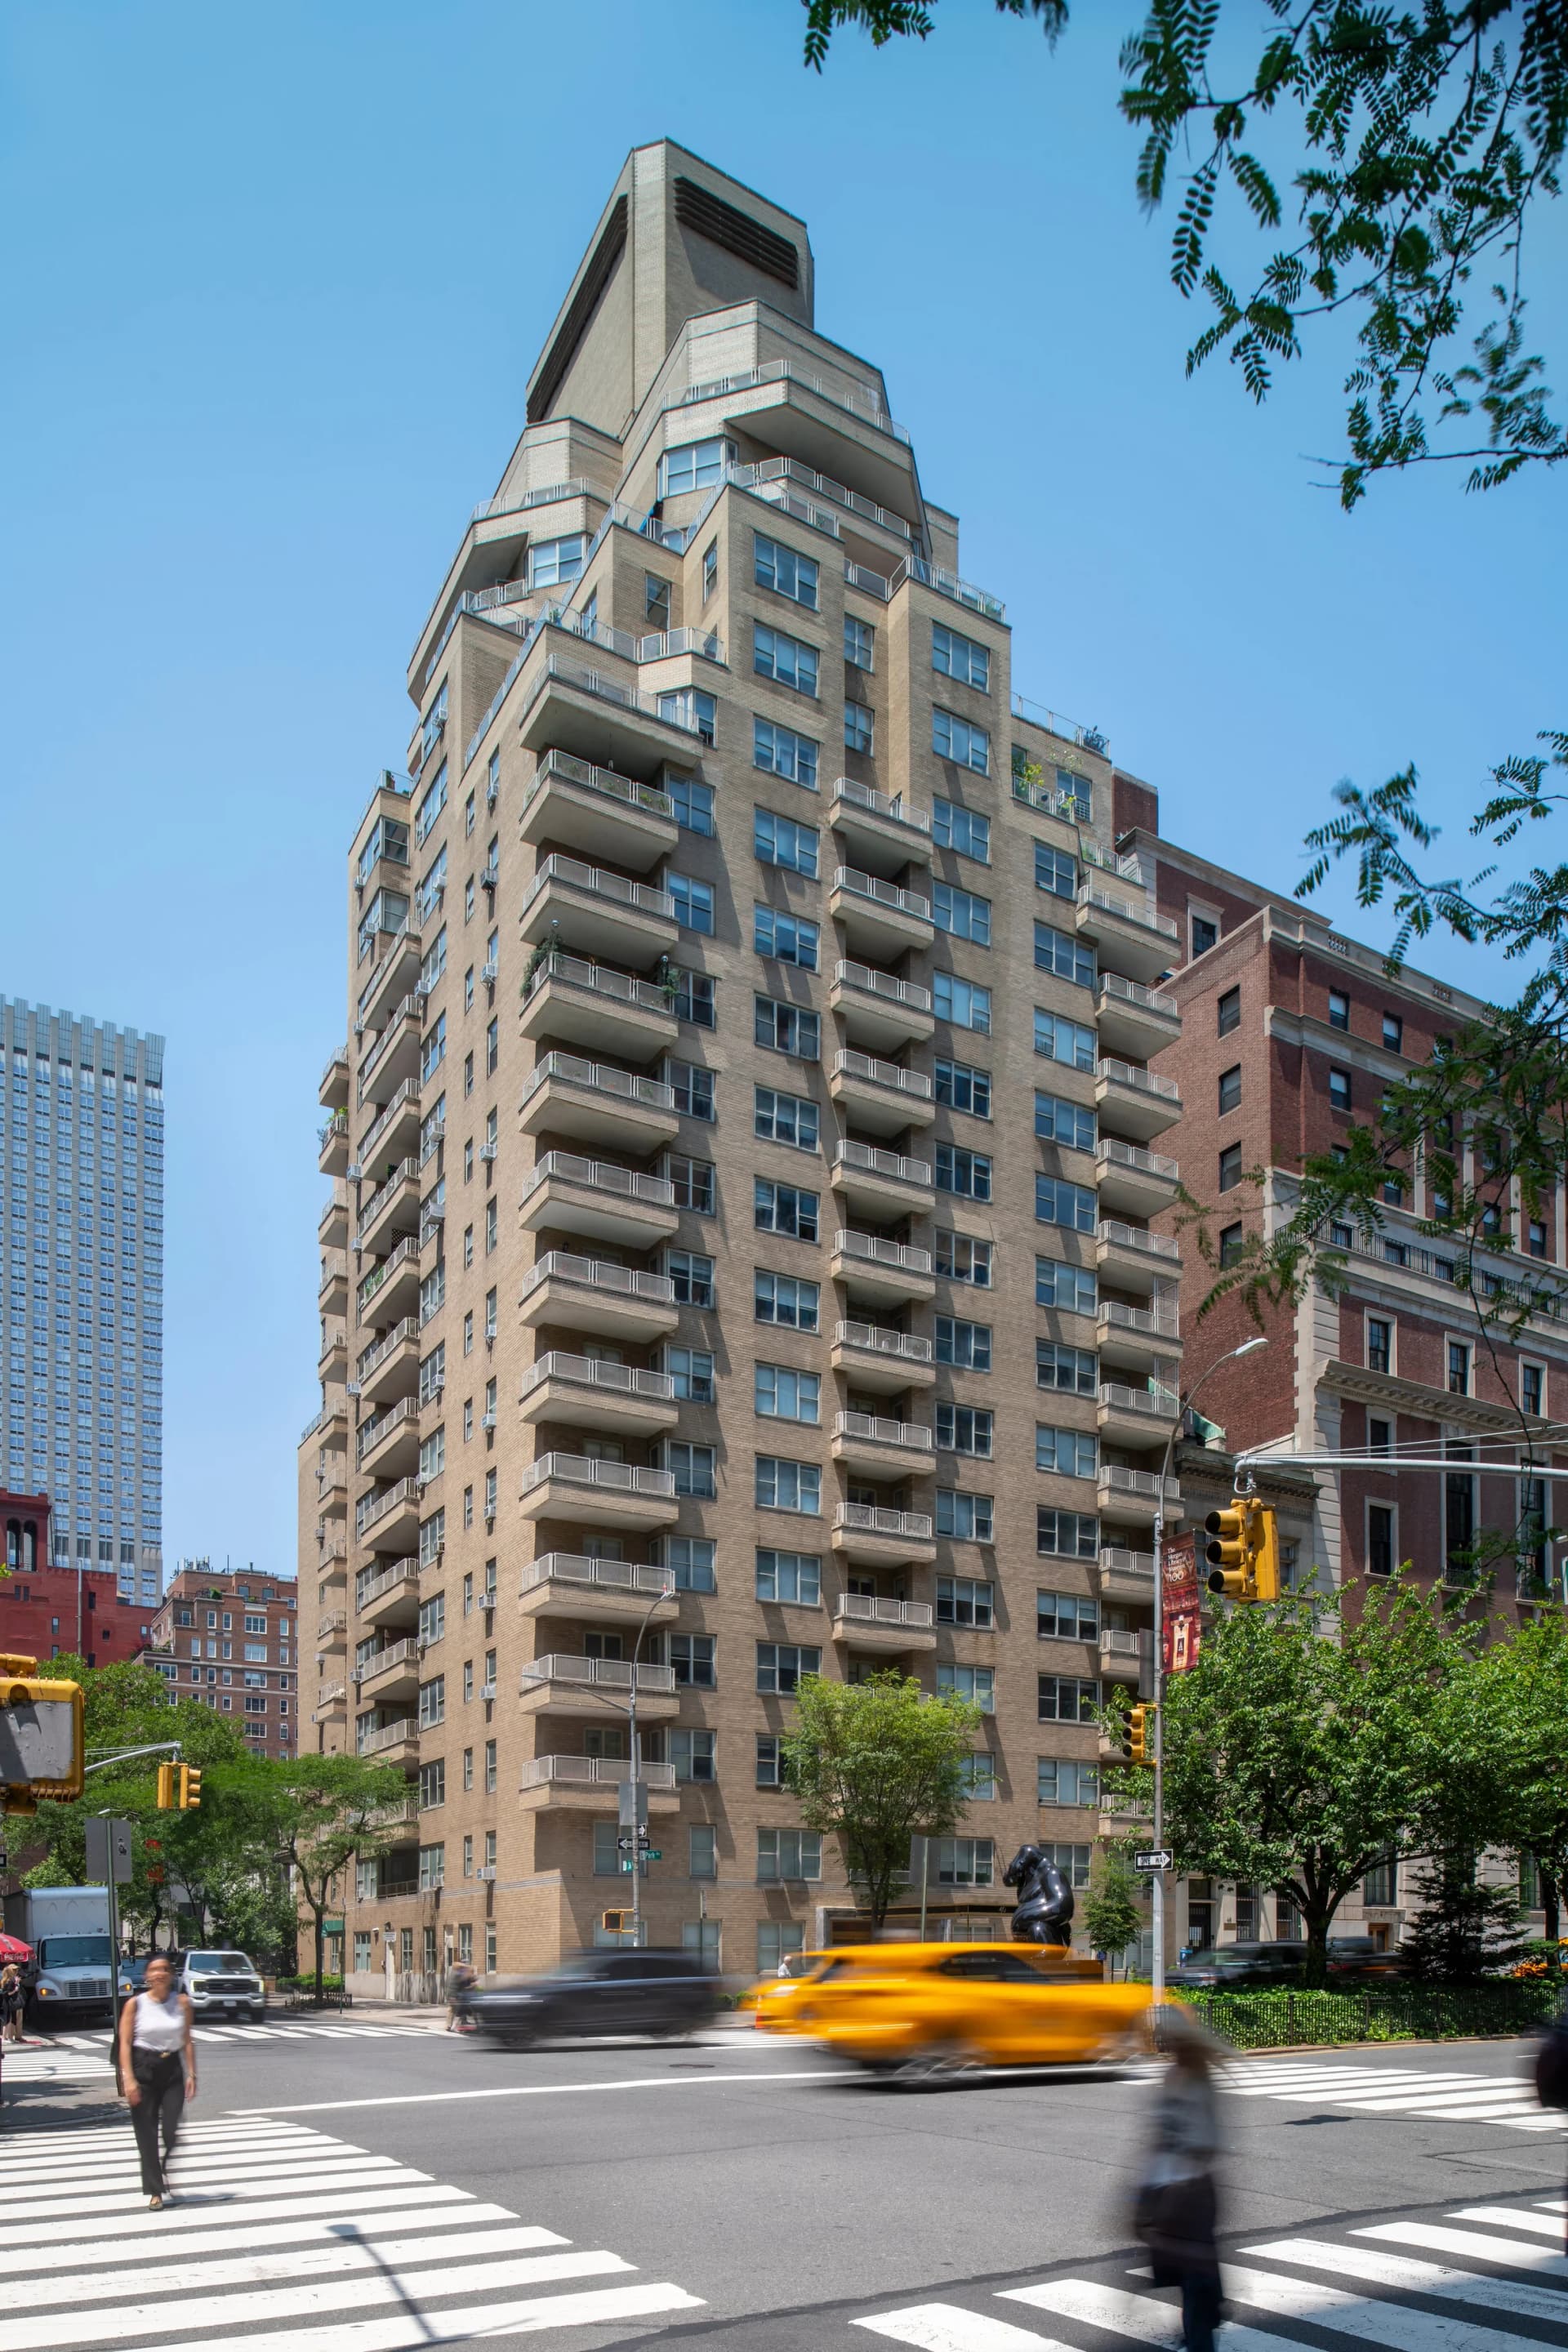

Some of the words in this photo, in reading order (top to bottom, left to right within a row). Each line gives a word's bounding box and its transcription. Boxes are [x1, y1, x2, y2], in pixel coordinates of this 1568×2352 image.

[1169, 1570, 1184, 1582] 100
[1140, 1856, 1151, 1864] ONE
[1156, 1855, 1166, 1864] WAY
